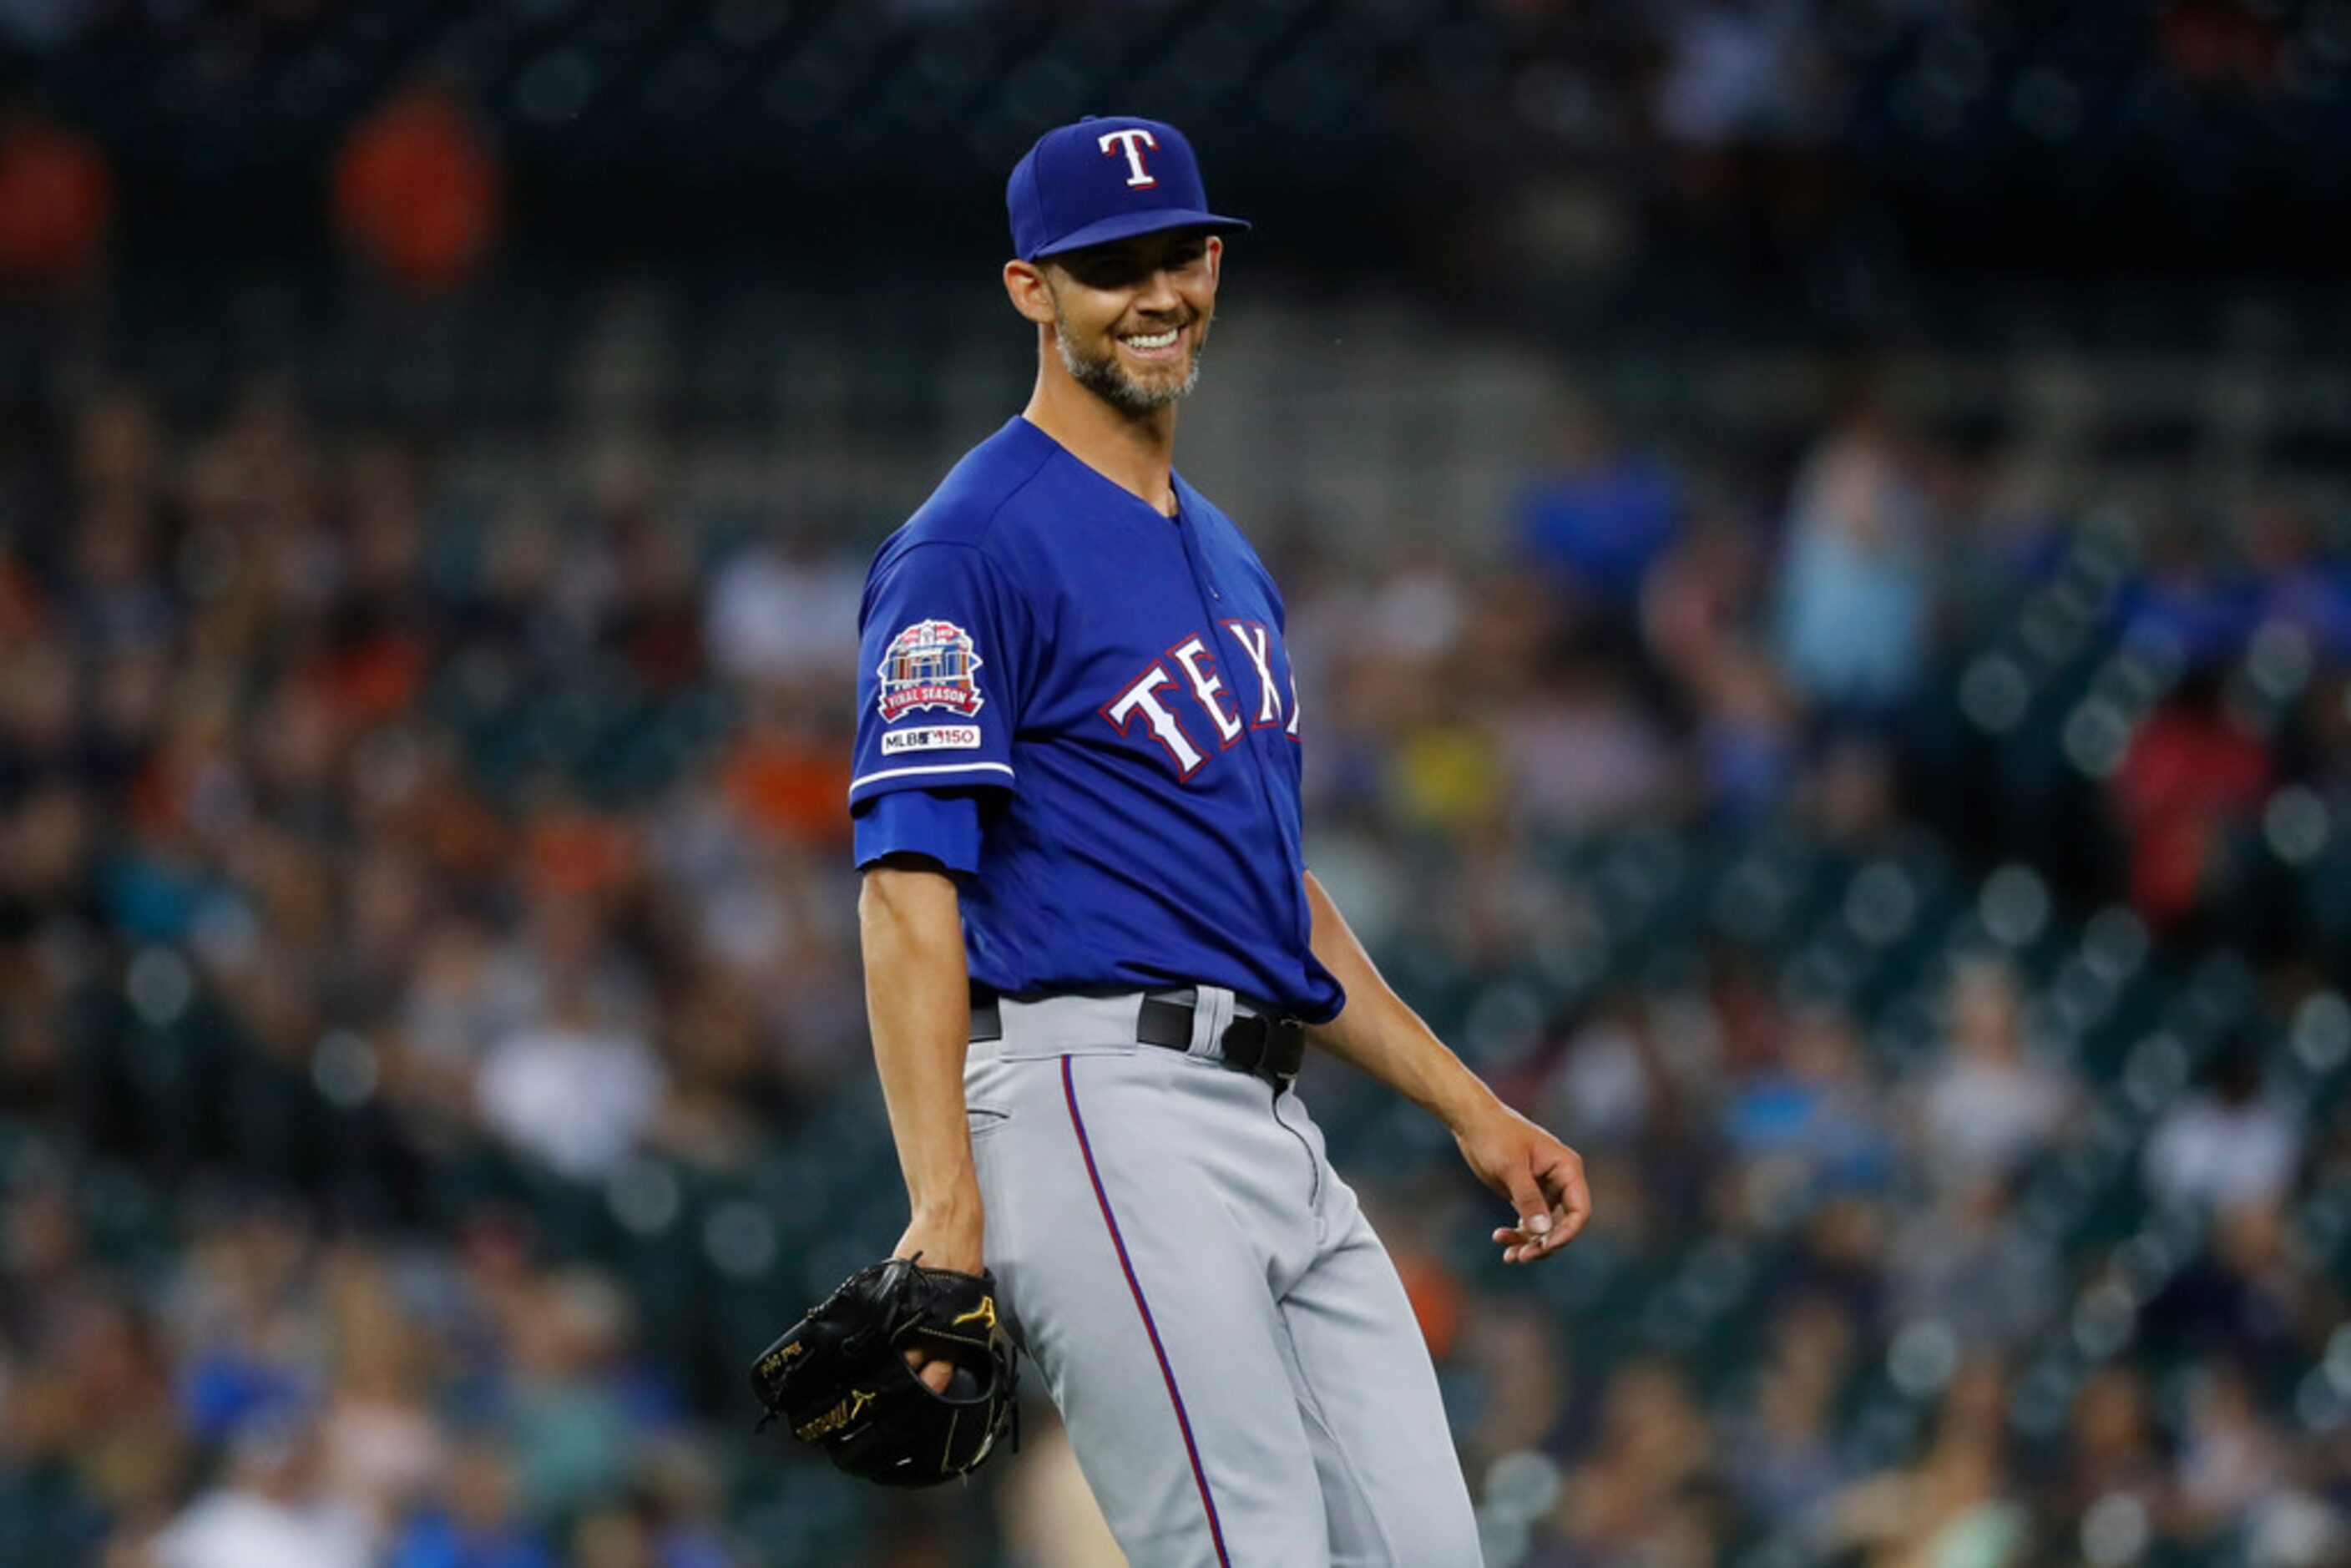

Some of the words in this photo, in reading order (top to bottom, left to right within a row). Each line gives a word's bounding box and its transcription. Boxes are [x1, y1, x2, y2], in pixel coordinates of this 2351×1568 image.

[1098, 129, 1159, 190] T
[888, 690, 919, 708] FINAL
[922, 687, 967, 704] SEASON
[886, 732, 918, 750] MLB
